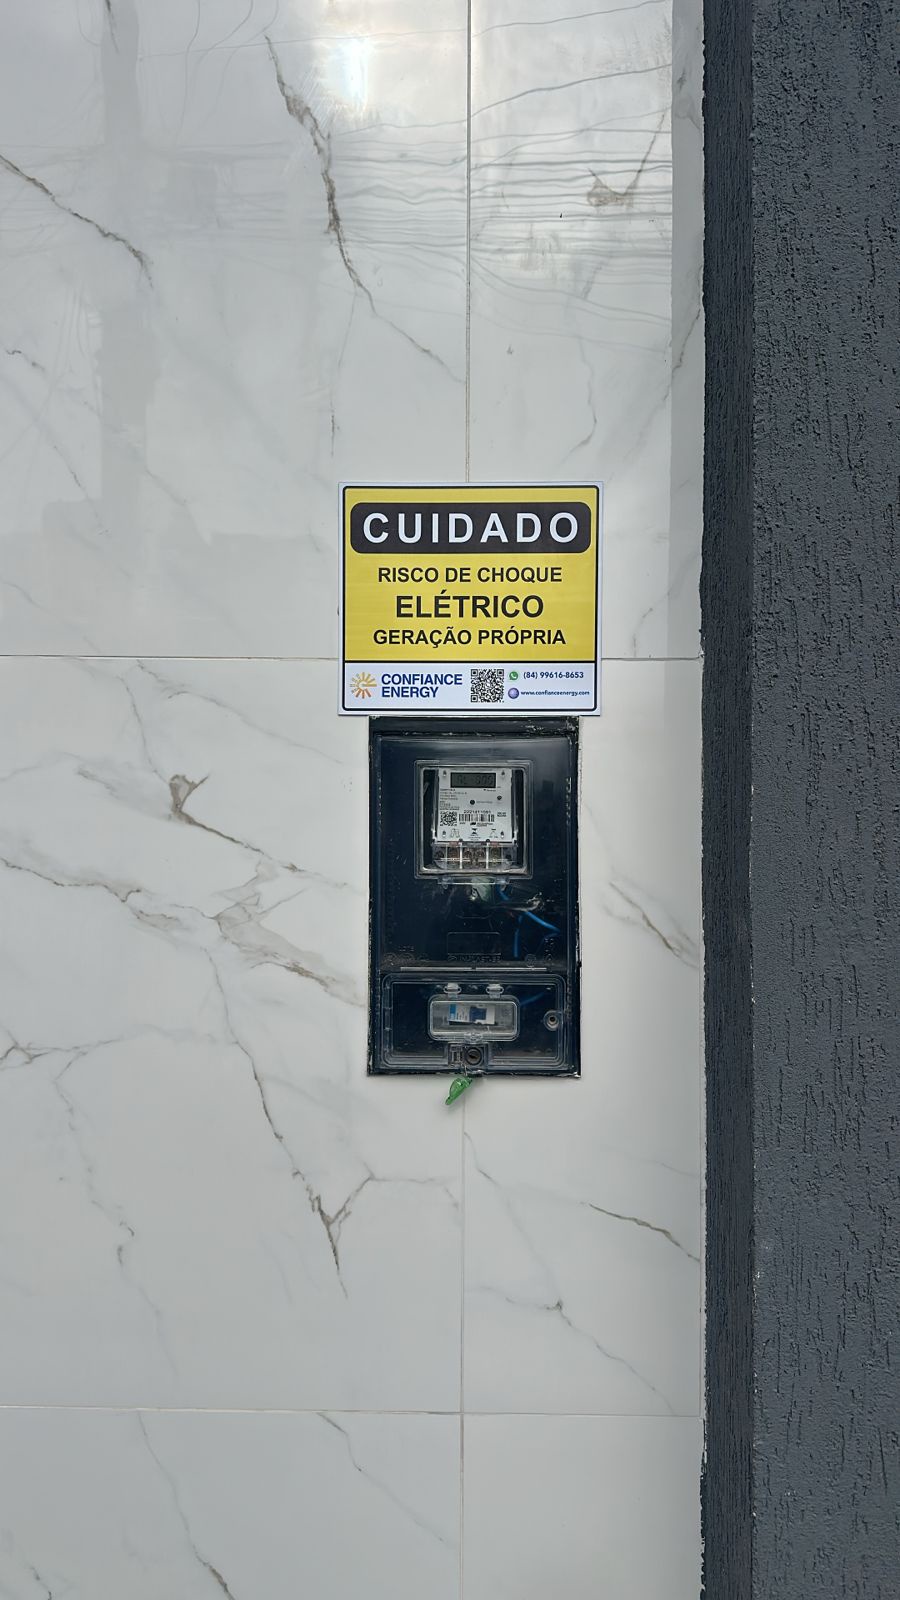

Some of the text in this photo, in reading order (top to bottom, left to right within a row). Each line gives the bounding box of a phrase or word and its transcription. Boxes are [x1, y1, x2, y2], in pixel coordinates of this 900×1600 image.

[363, 512, 578, 544] CUIDADO
[378, 567, 563, 584] RISCO DE CHOQUE
[396, 589, 544, 619] ELÉTRICO
[373, 626, 567, 648] GERAÇÃO PRÓPRIA
[381, 673, 463, 686] CONFIANCE
[523, 671, 584, 680] (84) 99616-8653
[381, 686, 439, 698] ENERGY
